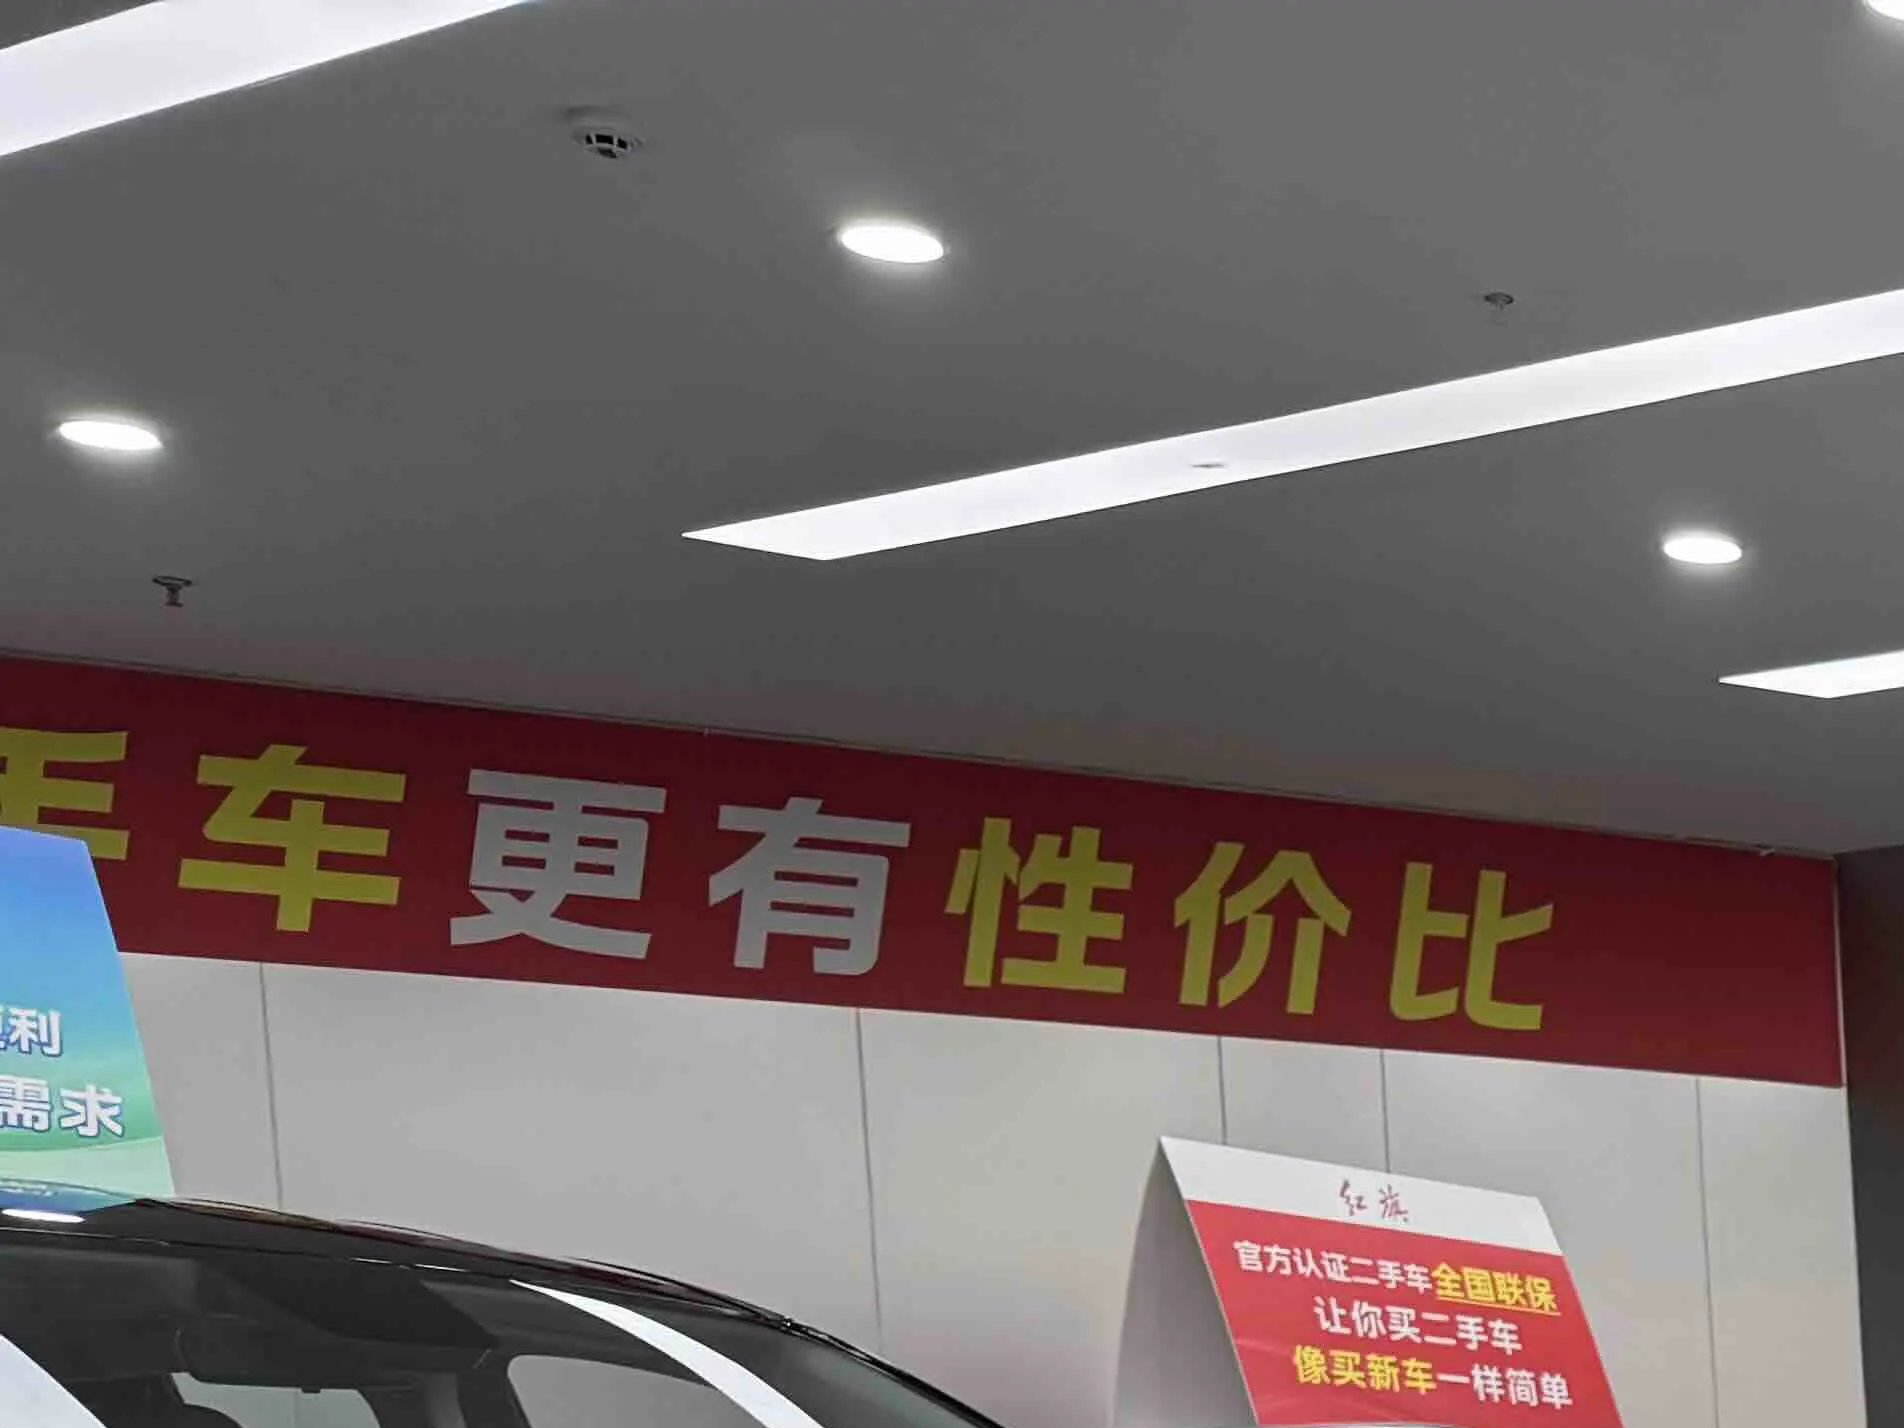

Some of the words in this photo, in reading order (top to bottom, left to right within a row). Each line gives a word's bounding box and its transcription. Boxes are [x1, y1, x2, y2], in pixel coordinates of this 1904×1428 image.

[0, 1007, 63, 1057] 利
[1233, 1240, 1560, 1313] 官方认证二手车全国联保
[1313, 1296, 1522, 1356] 让你买二手车
[1293, 1345, 1573, 1410] 像买新车一样简单
